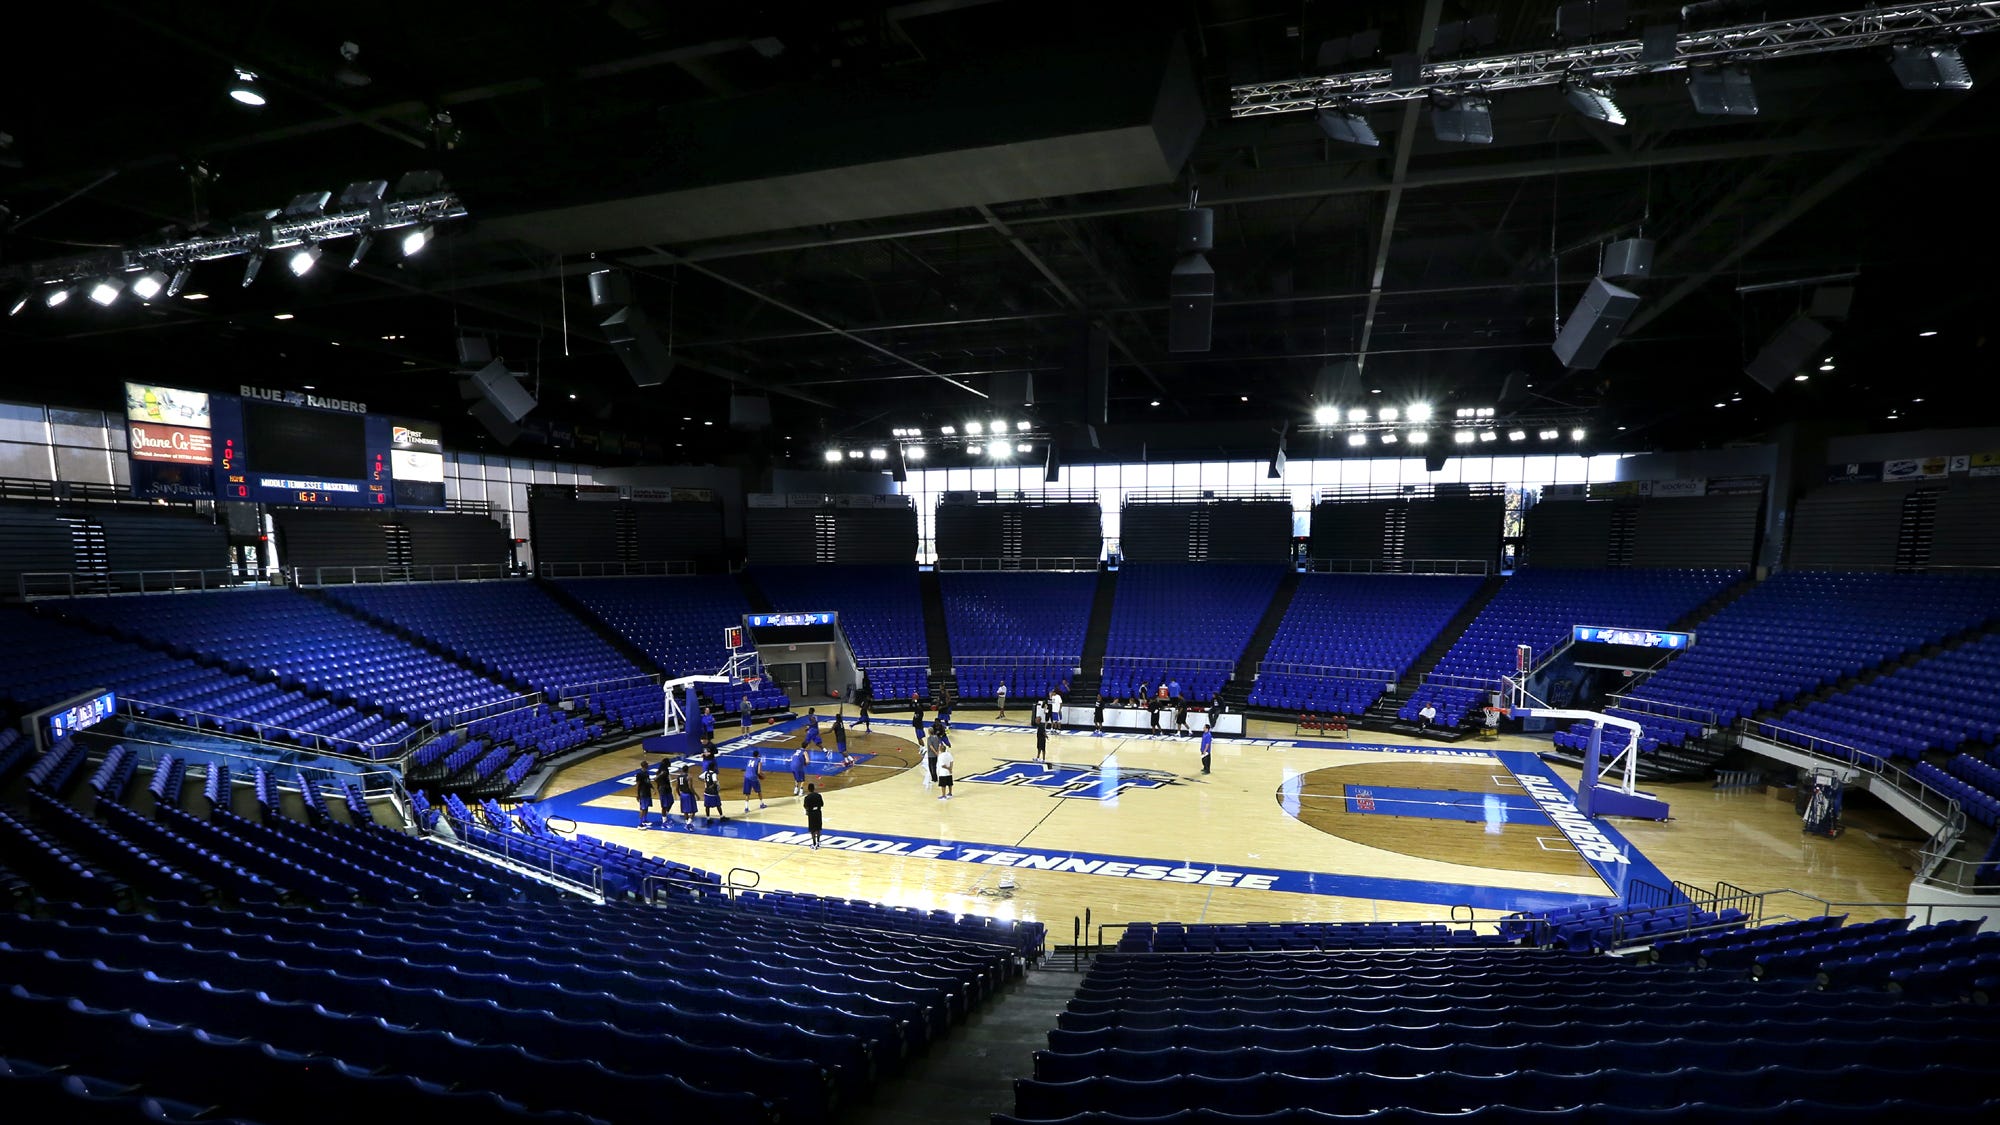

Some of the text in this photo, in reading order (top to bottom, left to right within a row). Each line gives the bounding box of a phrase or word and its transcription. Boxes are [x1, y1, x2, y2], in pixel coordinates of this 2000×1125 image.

[240, 385, 282, 402] BLUE
[307, 395, 367, 413] RAIDERS
[132, 427, 172, 449] Shane
[408, 437, 439, 445] TENNESSEE
[239, 485, 246, 496] 0
[261, 478, 359, 492] MIDDLE TENNESSEE BASKETBALL
[377, 494, 384, 504] 0
[754, 617, 760, 625] 0
[822, 615, 828, 623] 0
[1581, 629, 1589, 639] 0
[1669, 636, 1678, 646] 0
[685, 730, 784, 762] RIDERS
[1514, 773, 1572, 804] BLUE
[1538, 800, 1632, 865] RAIDERS
[759, 831, 1280, 890] MIDDLE TENNESSEE
